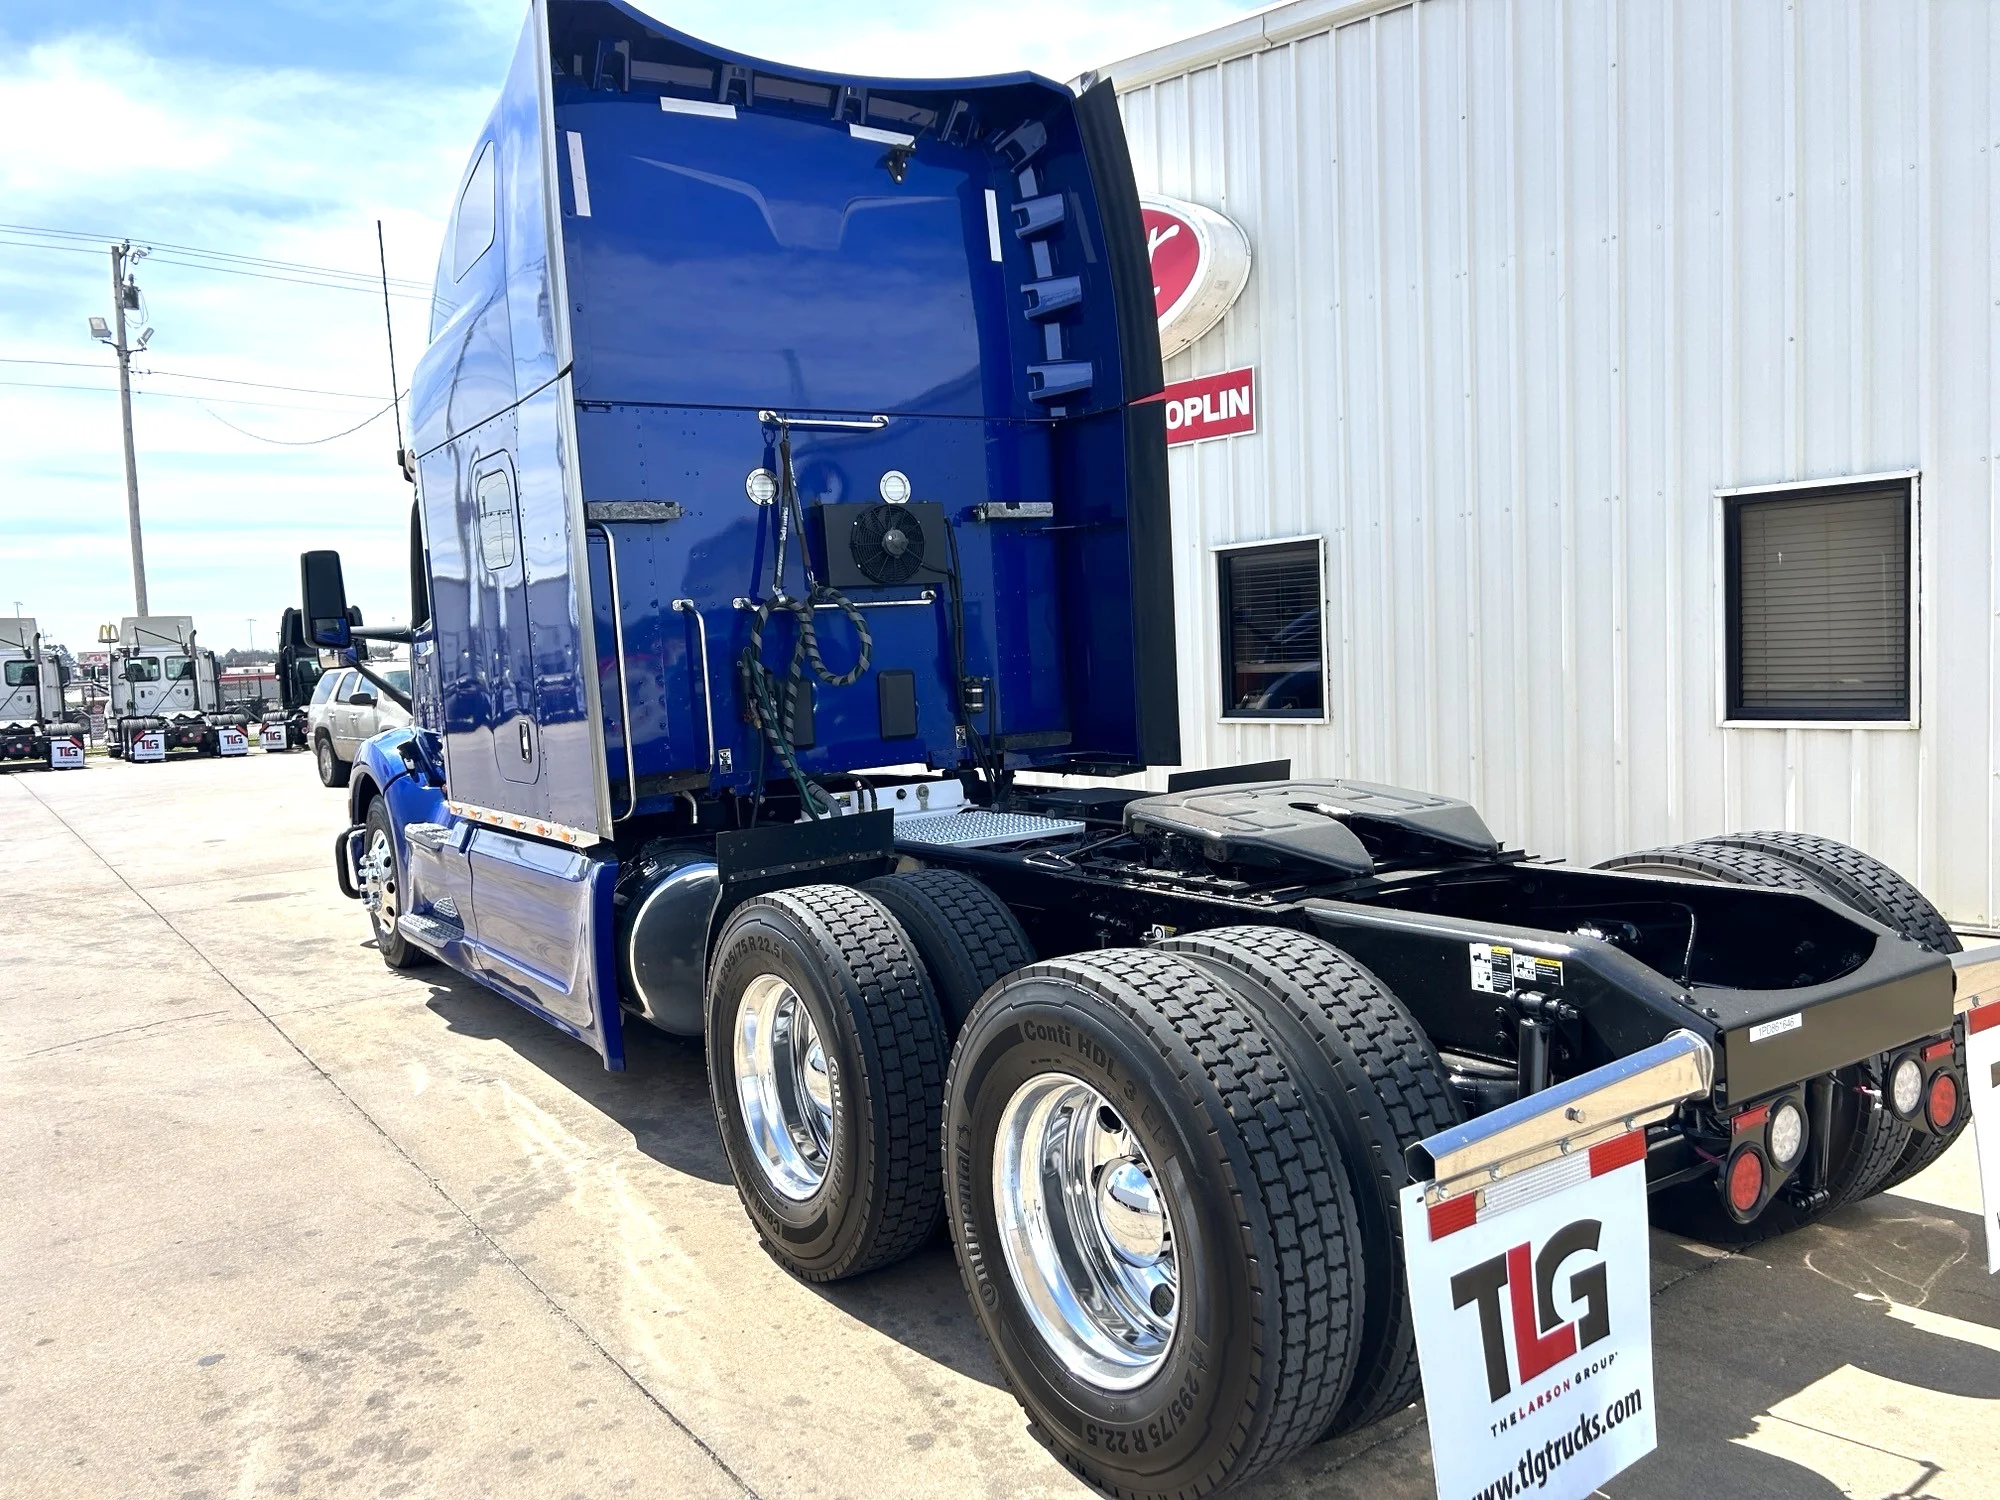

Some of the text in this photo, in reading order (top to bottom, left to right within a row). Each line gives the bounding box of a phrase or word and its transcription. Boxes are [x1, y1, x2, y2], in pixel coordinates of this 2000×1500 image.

[1166, 385, 1250, 430] OPLIN
[56, 746, 78, 757] TLG
[139, 739, 159, 749] TLG
[224, 734, 243, 744] TLG
[263, 731, 281, 741] TLG
[721, 939, 748, 980] 295/75
[748, 936, 757, 951] R
[758, 936, 780, 959] 22.5
[1024, 1020, 1071, 1047] Conti
[1078, 1033, 1116, 1082] HDL
[1123, 1080, 1137, 1101] 3
[955, 1145, 999, 1312] Continental
[1450, 1218, 1611, 1403] TLG
[1574, 1353, 1615, 1385] GROUP
[1148, 1368, 1200, 1449] 295/75
[1086, 1424, 1129, 1455] 22.5
[1132, 1429, 1148, 1453] R
[1472, 1388, 1642, 1500] w.tlgtrucks.com
